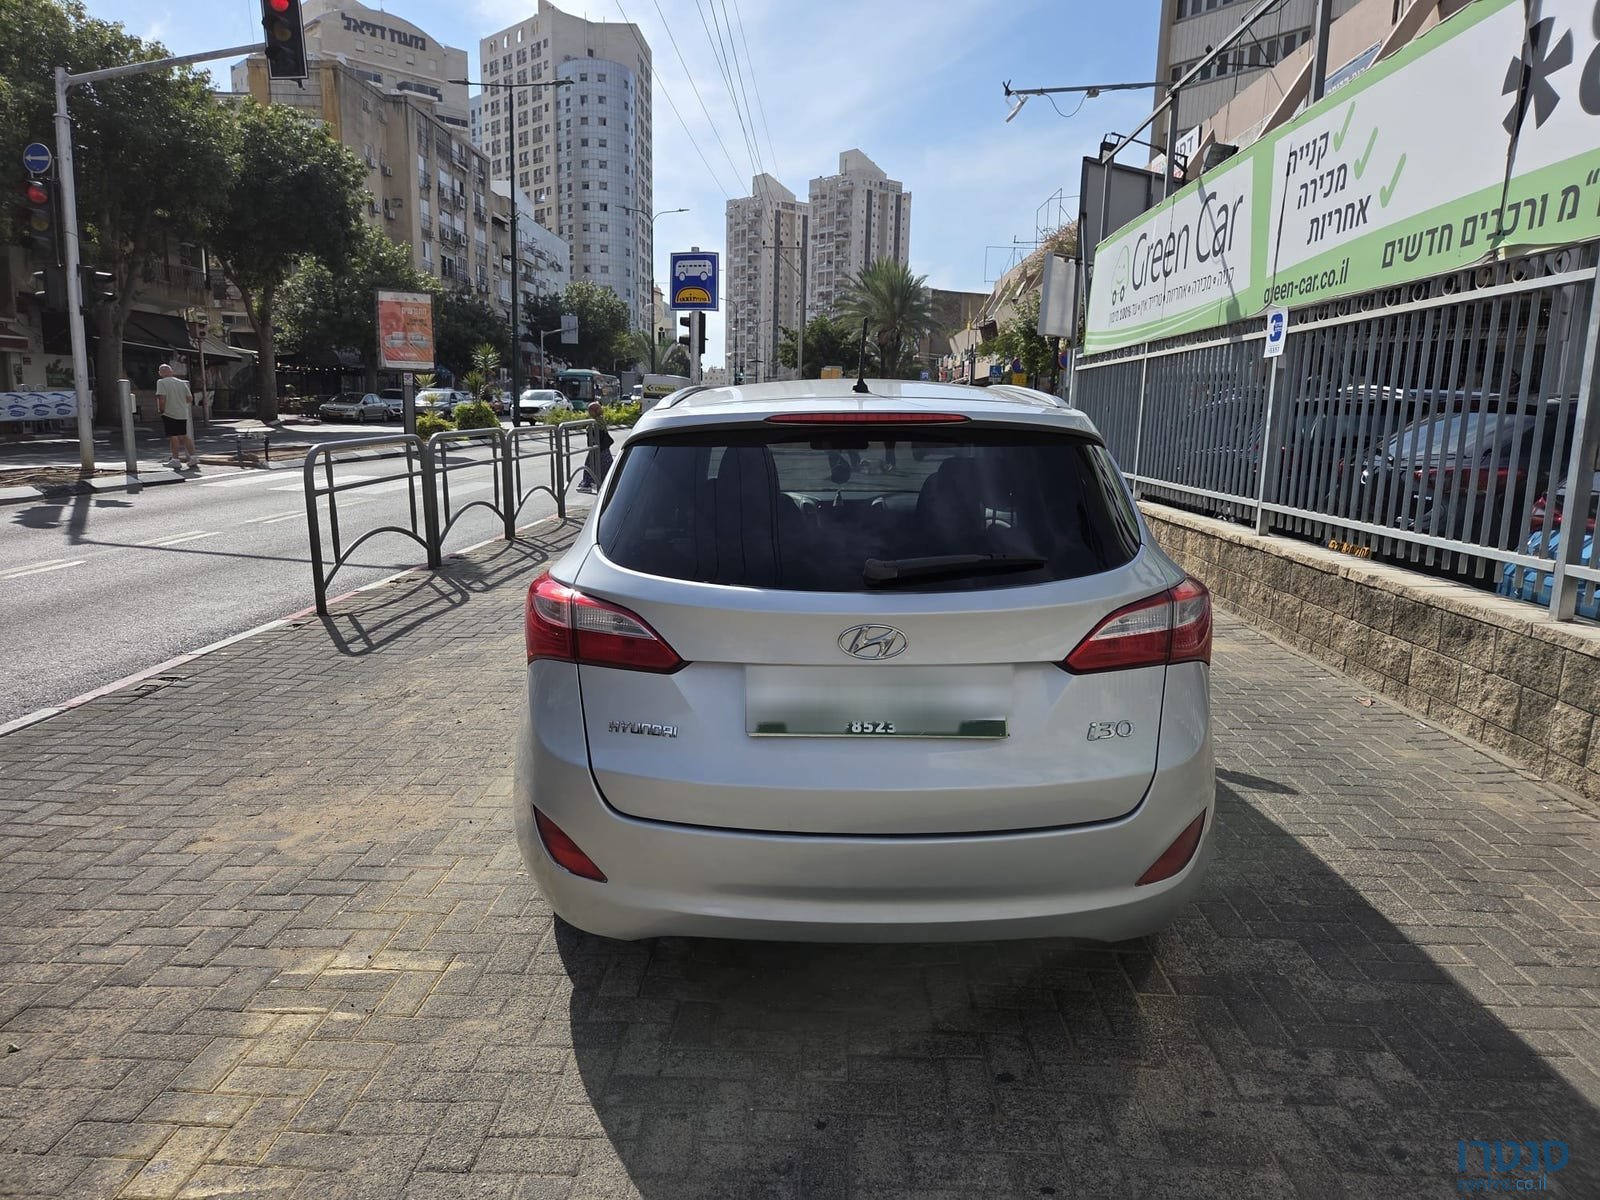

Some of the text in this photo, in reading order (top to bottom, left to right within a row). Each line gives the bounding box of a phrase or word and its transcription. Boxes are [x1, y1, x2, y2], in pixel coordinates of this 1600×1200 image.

[1297, 162, 1348, 210] מכירה
[1132, 191, 1244, 291] Green Car
[1306, 194, 1372, 246] אחריות
[1381, 223, 1454, 269] חדשים
[607, 720, 678, 738] HYUNDAI
[1087, 719, 1134, 741] i30
